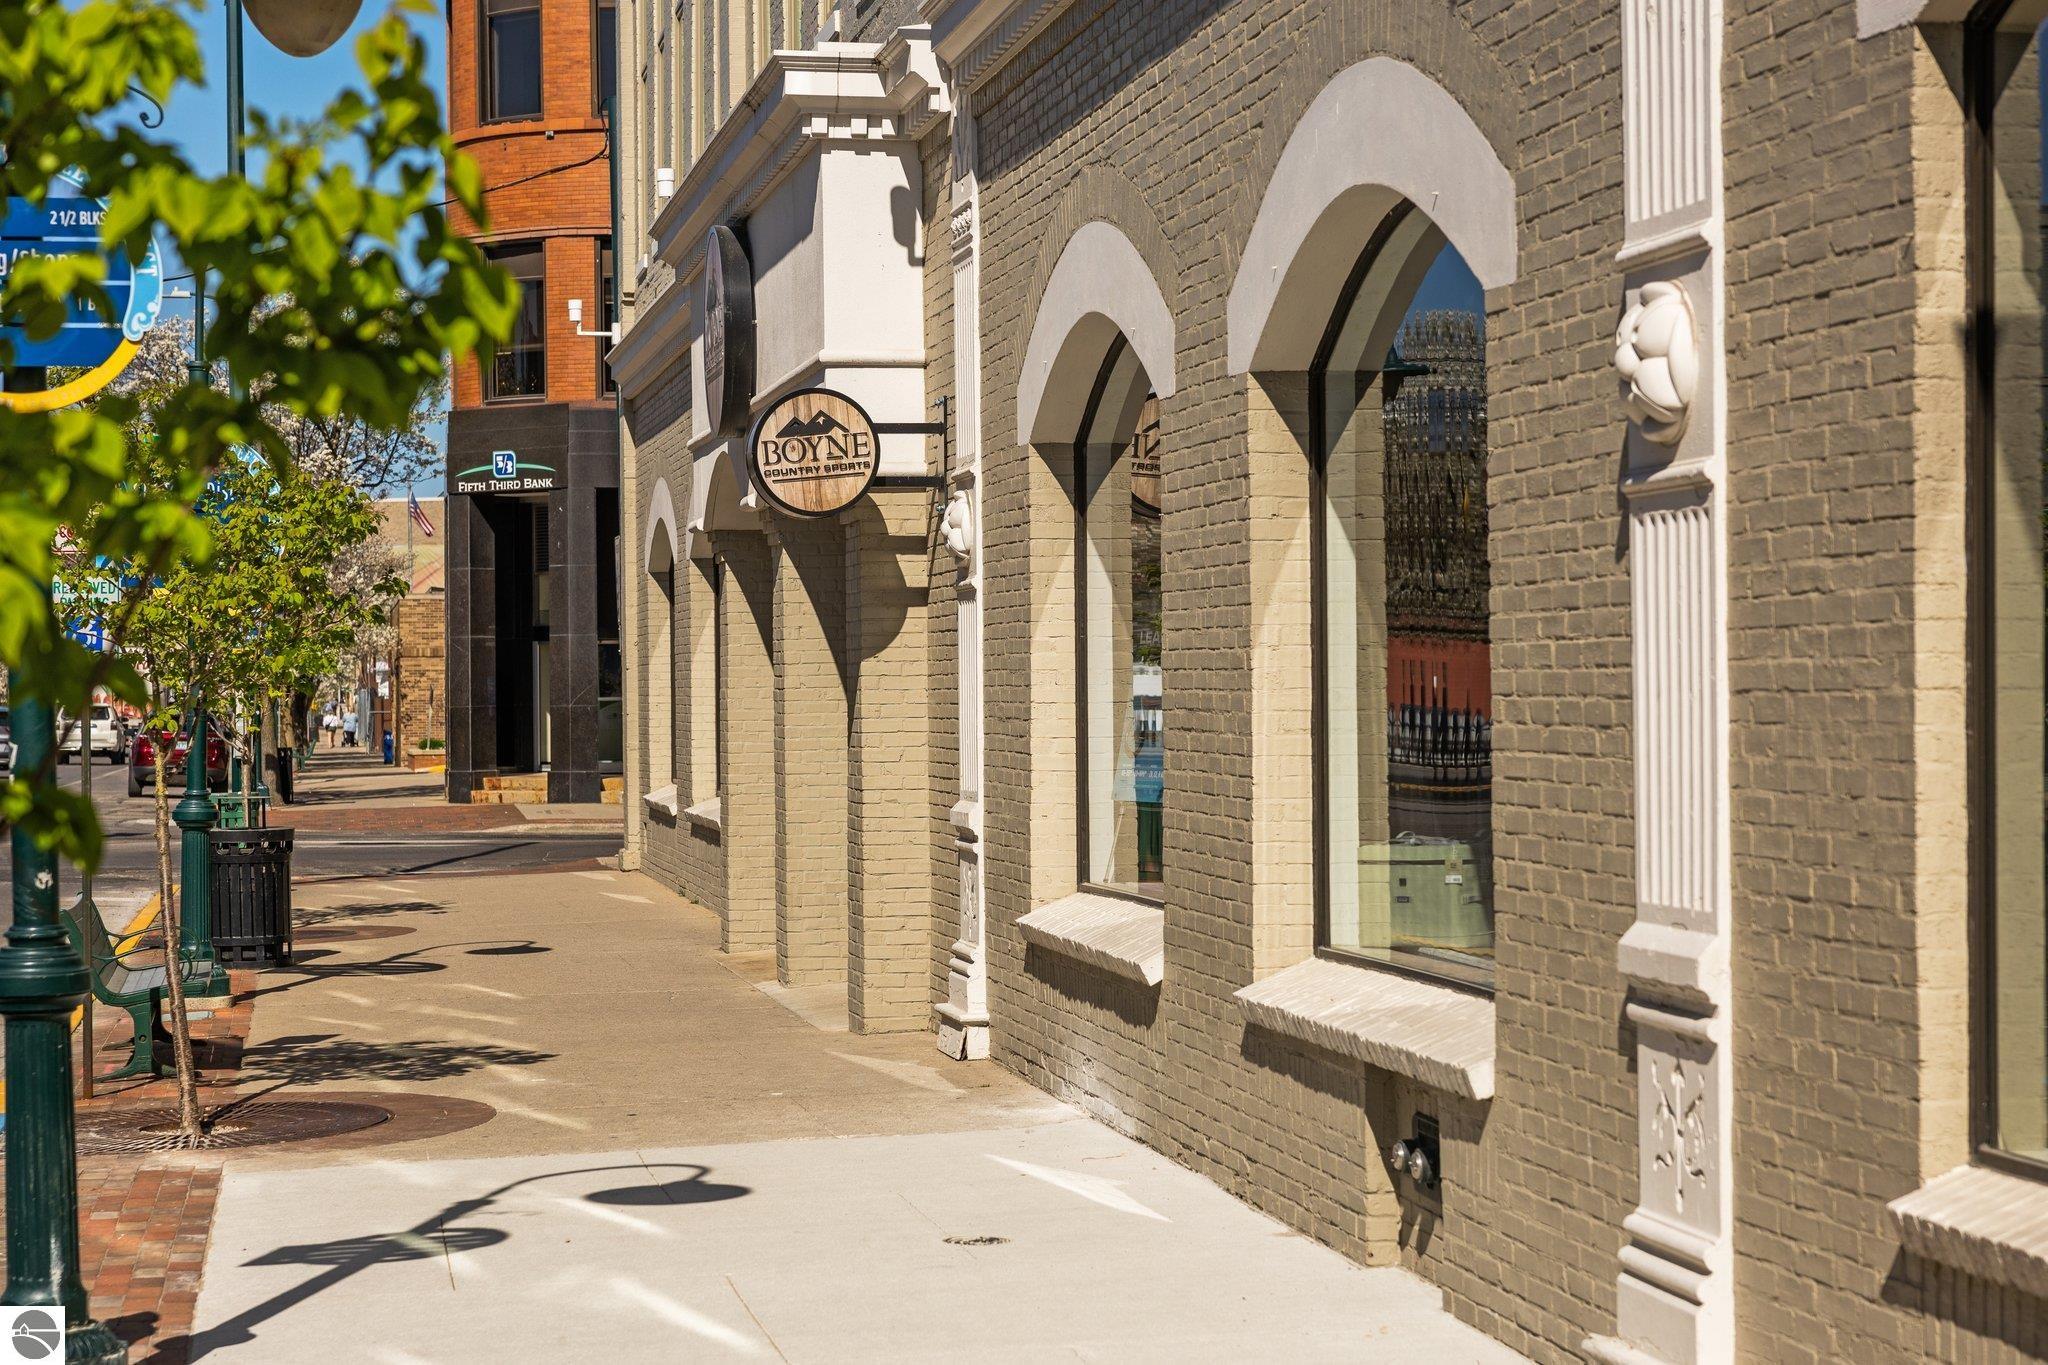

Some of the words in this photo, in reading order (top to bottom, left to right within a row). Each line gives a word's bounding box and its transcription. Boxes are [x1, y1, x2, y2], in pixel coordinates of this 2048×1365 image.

[50, 211, 58, 225] 2
[60, 210, 76, 226] 1/2
[761, 432, 870, 466] BOYNE
[763, 465, 821, 478] COUNTRY
[824, 461, 871, 474] SPORTS
[458, 481, 486, 492] FIFTH
[489, 479, 521, 491] THIRD
[524, 478, 553, 489] BANK
[53, 582, 116, 594] REVED
